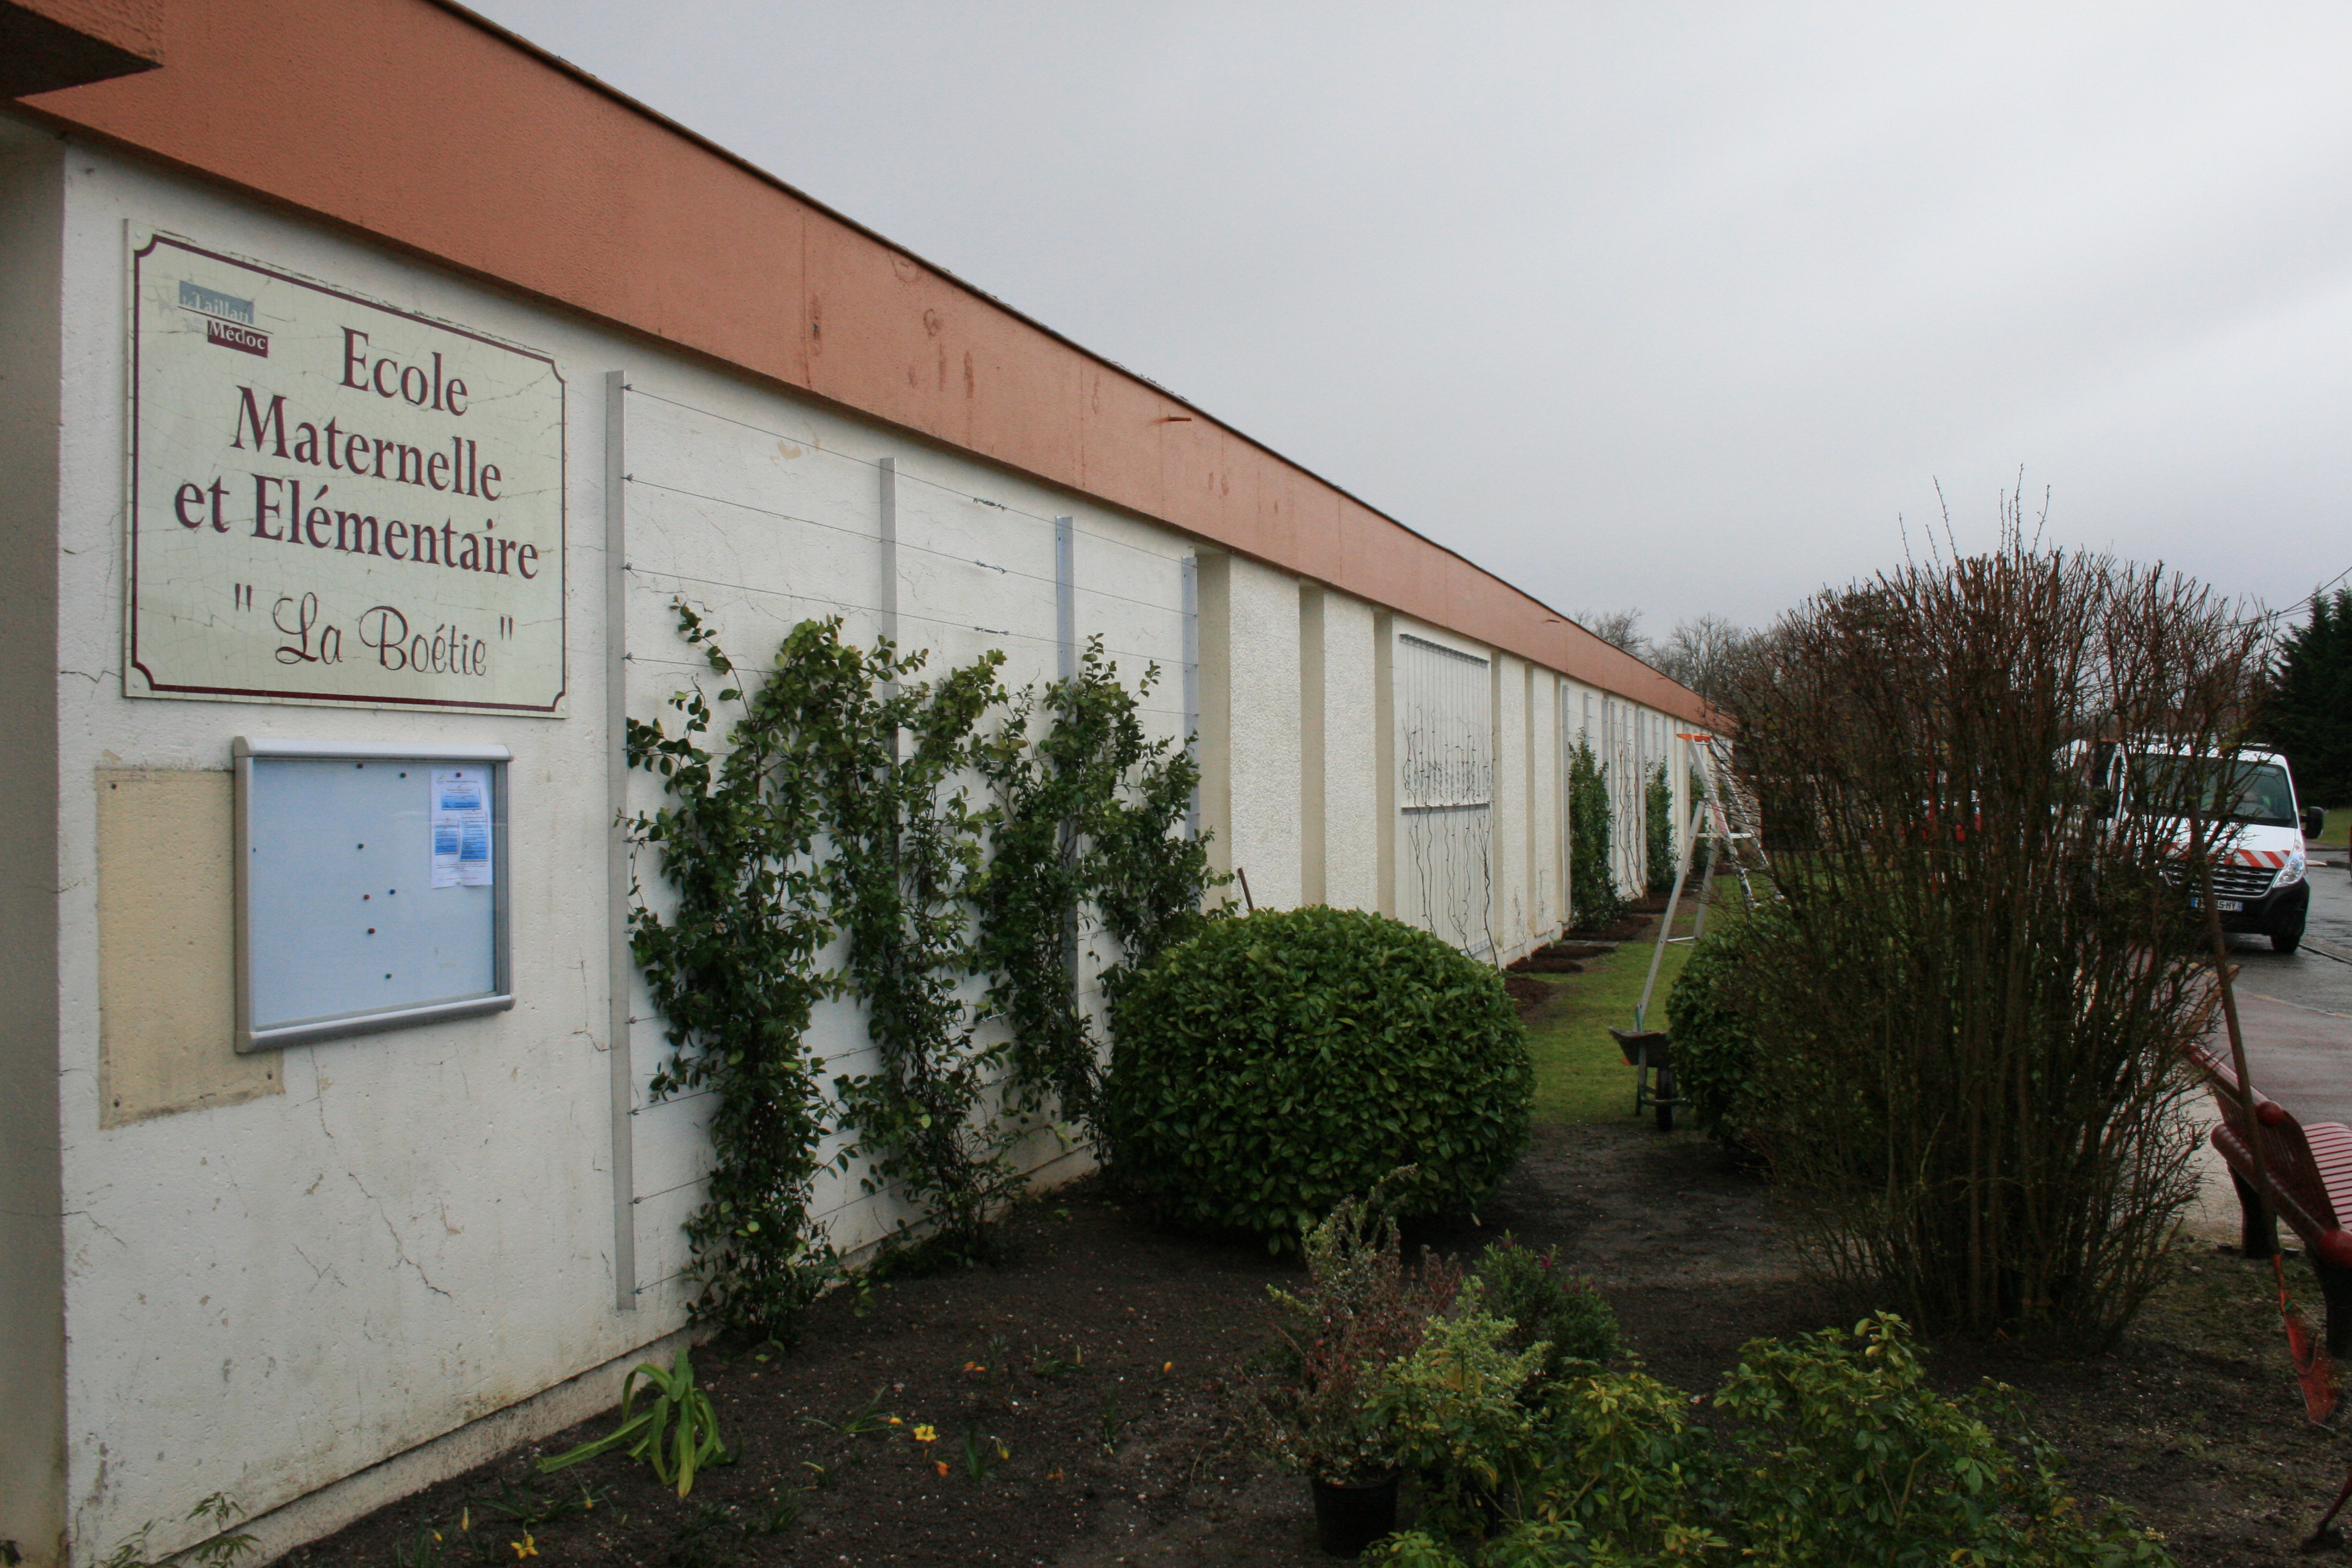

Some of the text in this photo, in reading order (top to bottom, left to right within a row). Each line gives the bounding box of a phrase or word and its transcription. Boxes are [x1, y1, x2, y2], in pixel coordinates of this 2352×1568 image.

[192, 292, 249, 324] Taillan
[209, 320, 267, 350] Médoc
[340, 326, 468, 416] Ecole
[230, 385, 502, 501] Maternelle
[175, 474, 539, 580] et Elémentaire
